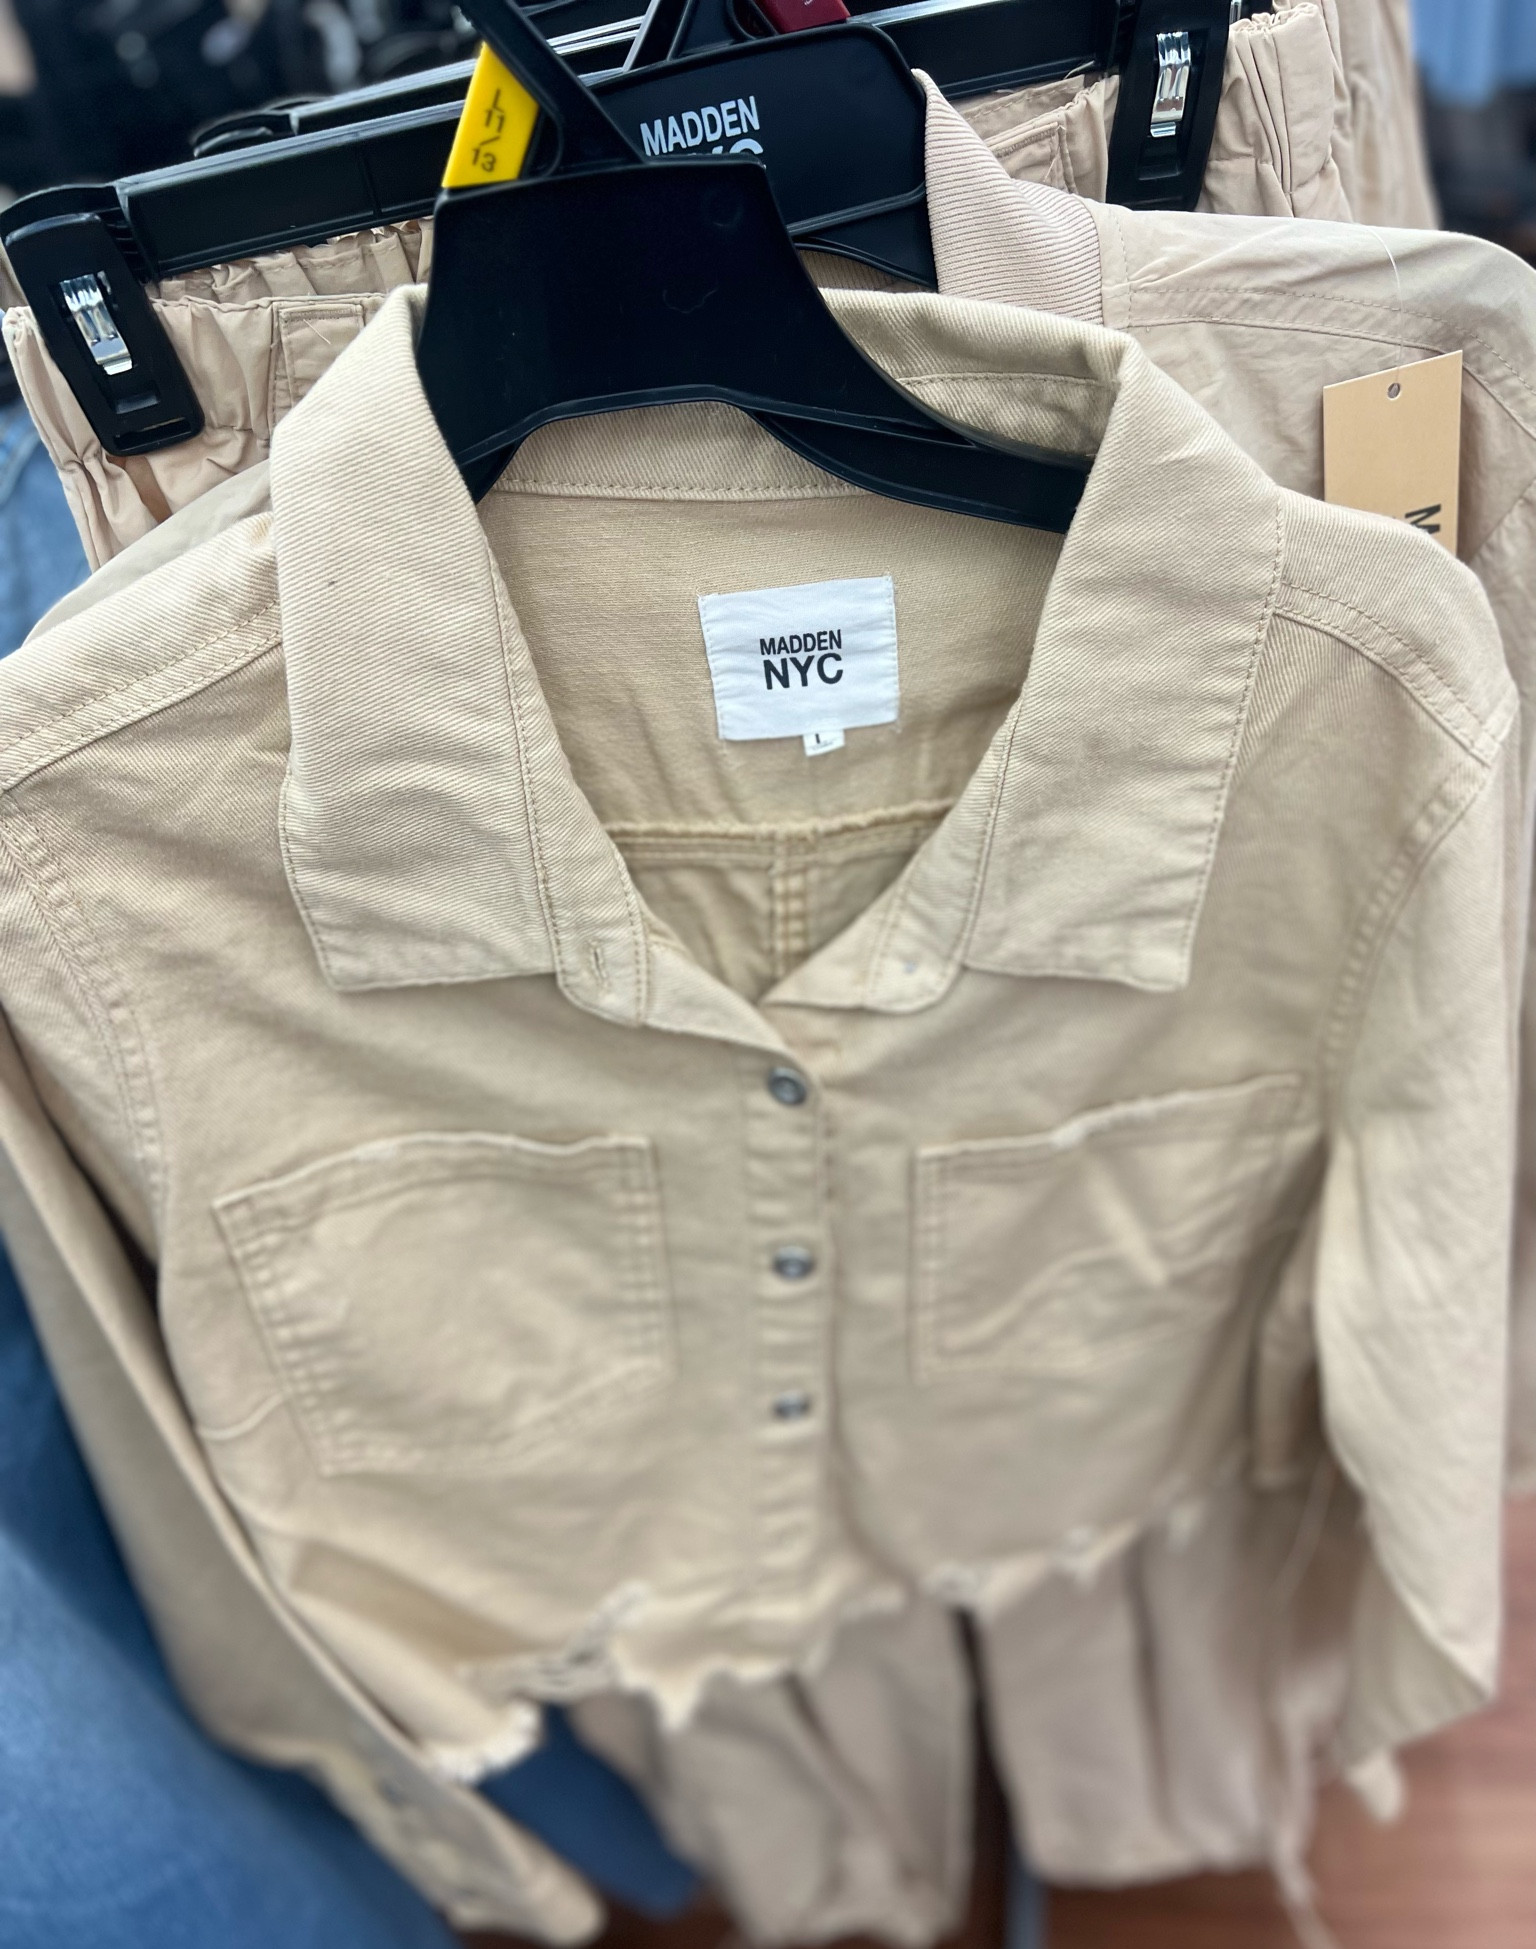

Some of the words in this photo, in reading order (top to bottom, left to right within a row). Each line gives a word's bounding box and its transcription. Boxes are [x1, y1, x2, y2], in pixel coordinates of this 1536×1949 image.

[640, 95, 760, 156] MADDEN
[472, 148, 497, 173] 13
[759, 629, 842, 655] MADDEN
[763, 652, 844, 690] NYC
